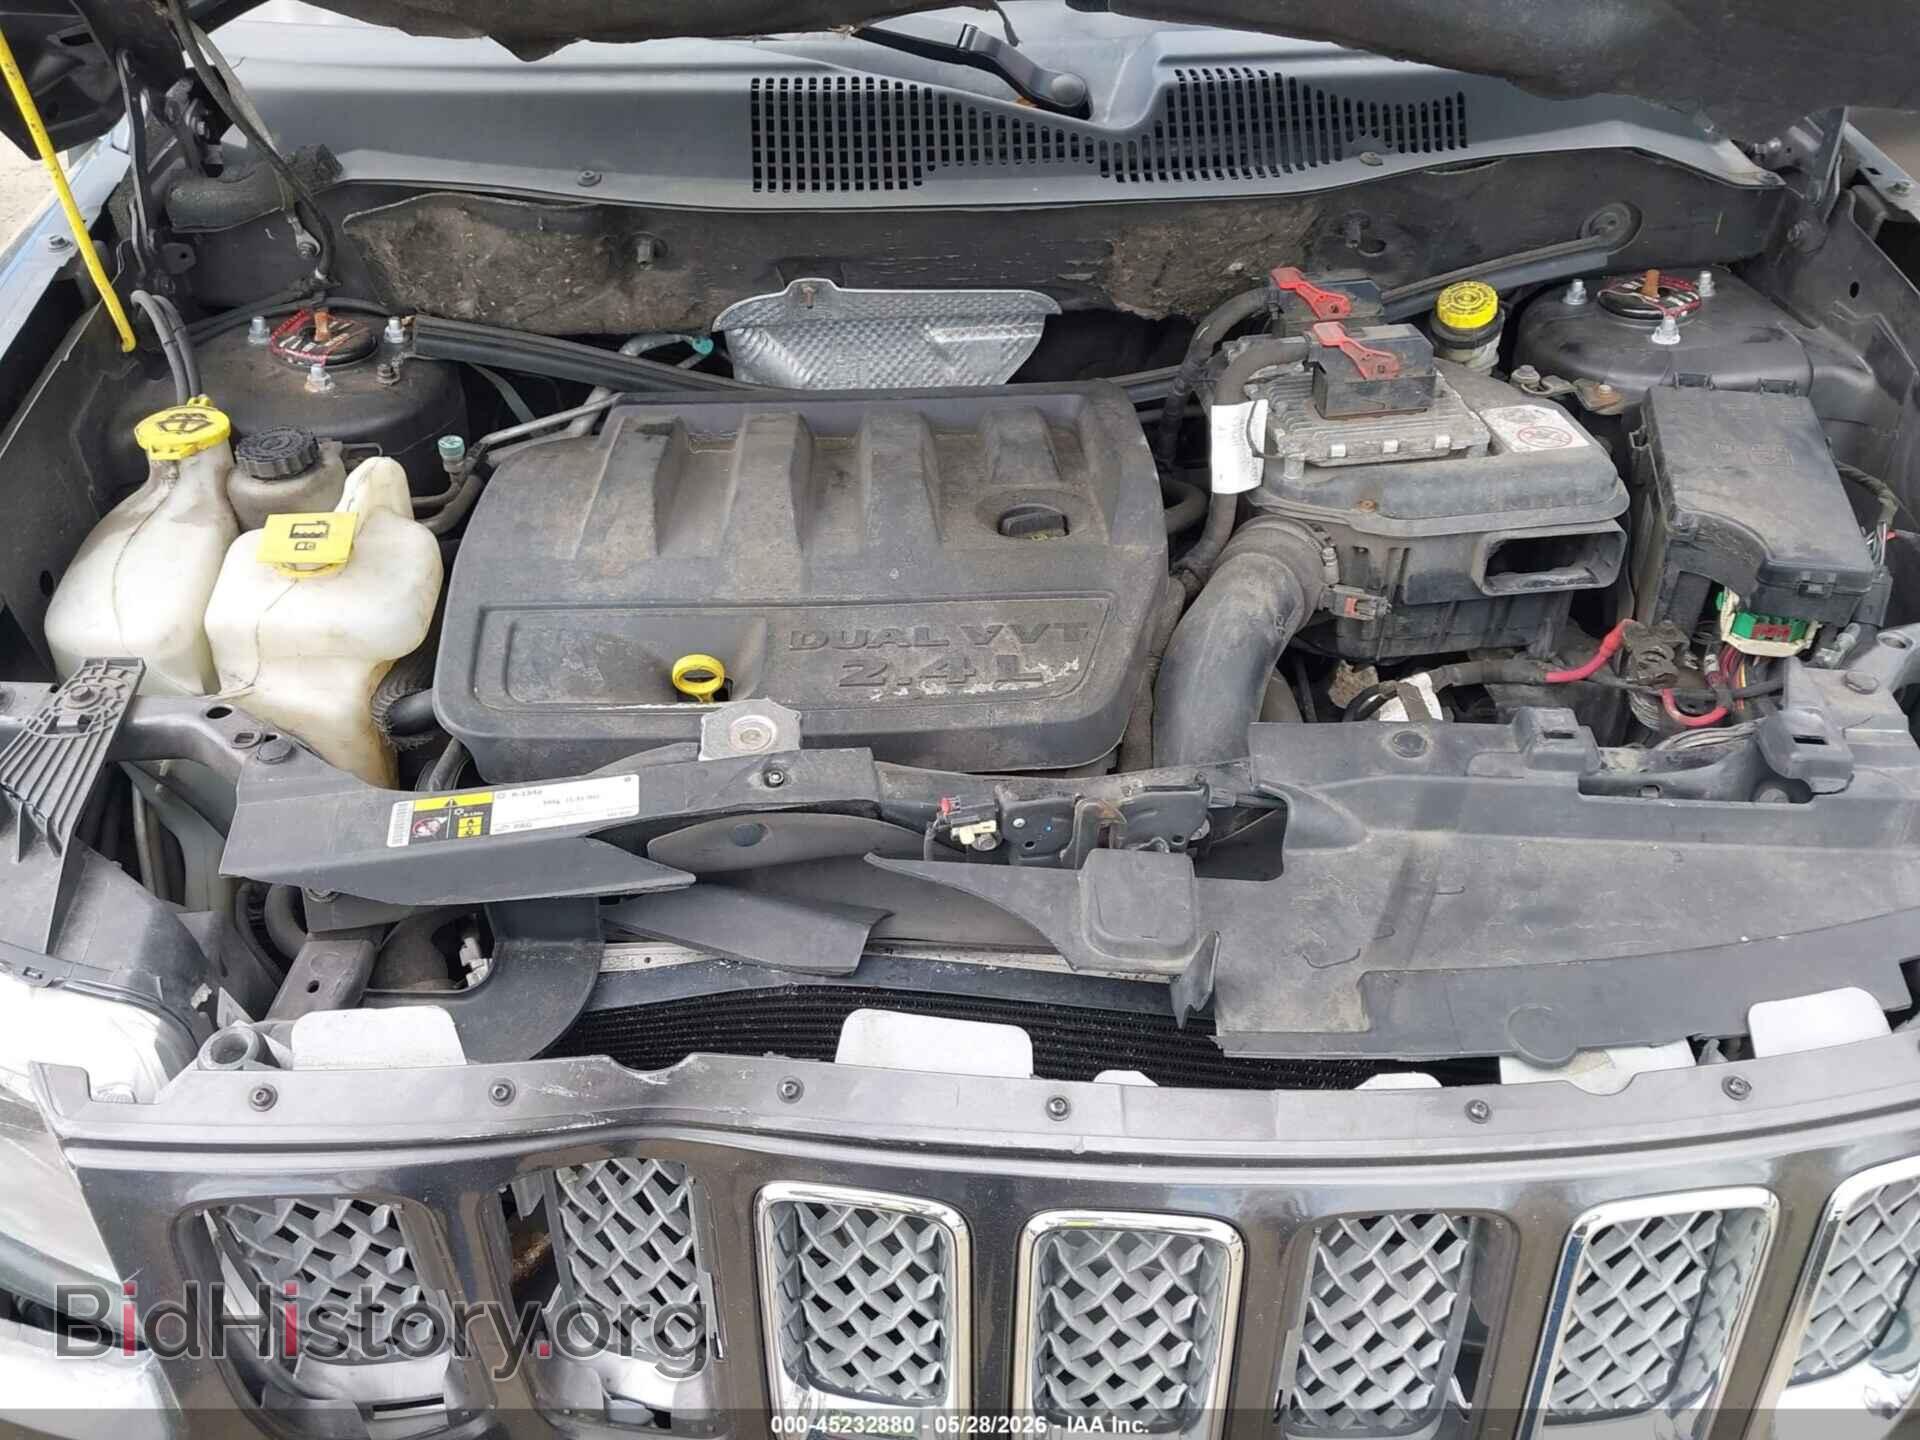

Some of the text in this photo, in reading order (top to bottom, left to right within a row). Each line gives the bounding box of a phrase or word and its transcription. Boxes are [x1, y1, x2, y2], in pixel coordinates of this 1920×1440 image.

[789, 622, 1089, 651] DUAL VVT
[838, 653, 1043, 688] 2.4L
